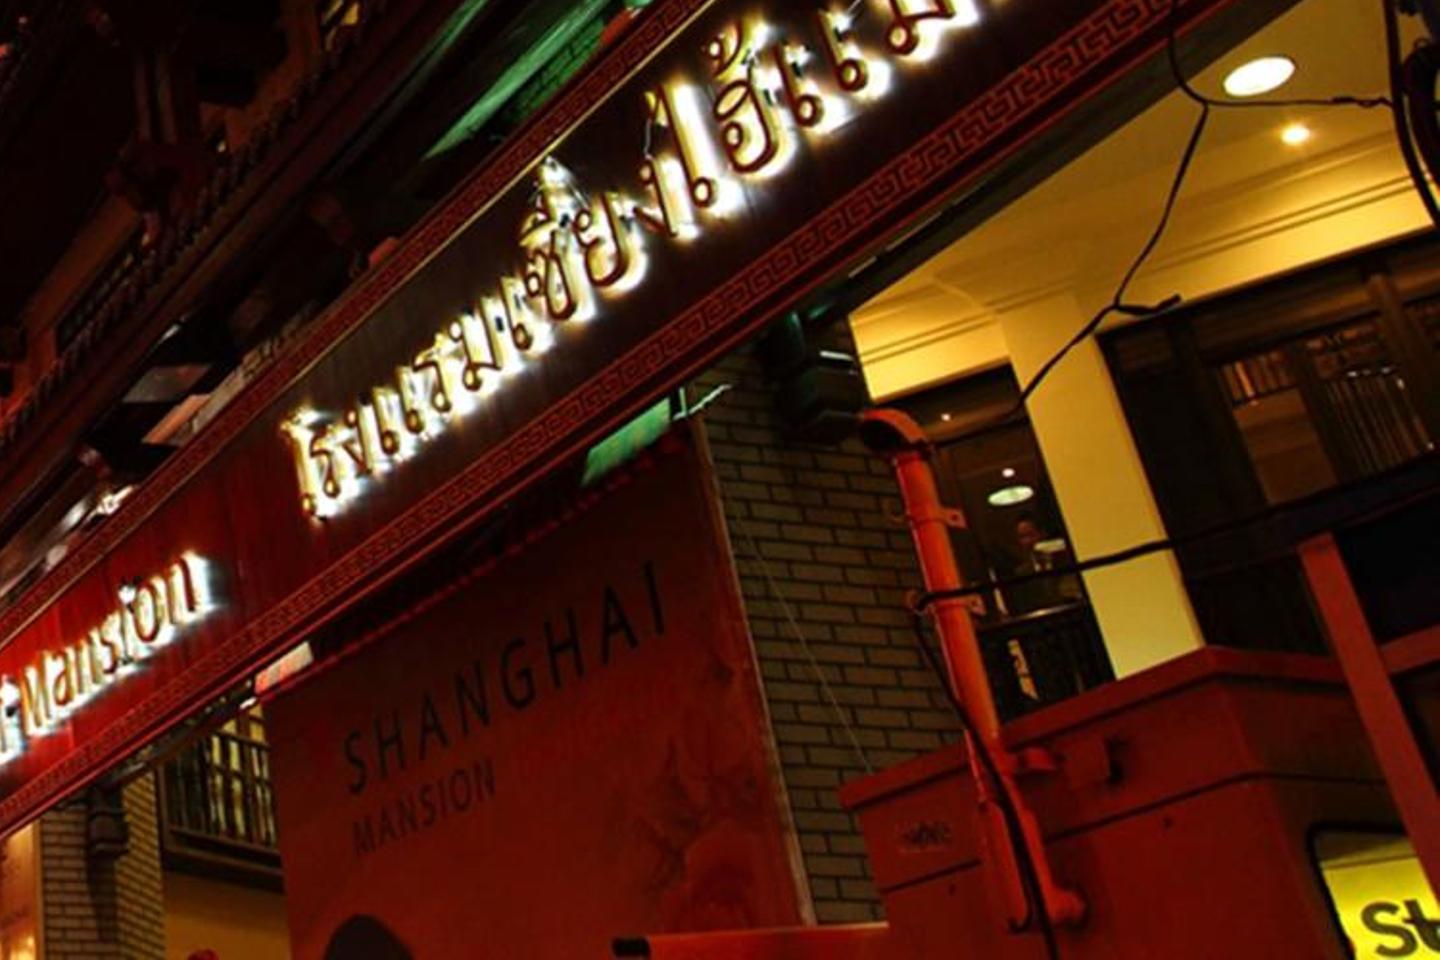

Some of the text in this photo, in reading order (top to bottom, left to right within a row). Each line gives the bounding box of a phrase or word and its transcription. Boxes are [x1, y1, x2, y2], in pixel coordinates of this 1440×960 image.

[20, 550, 212, 736] Mansion
[342, 560, 666, 797] SHANGHAI
[352, 758, 497, 857] MANSION
